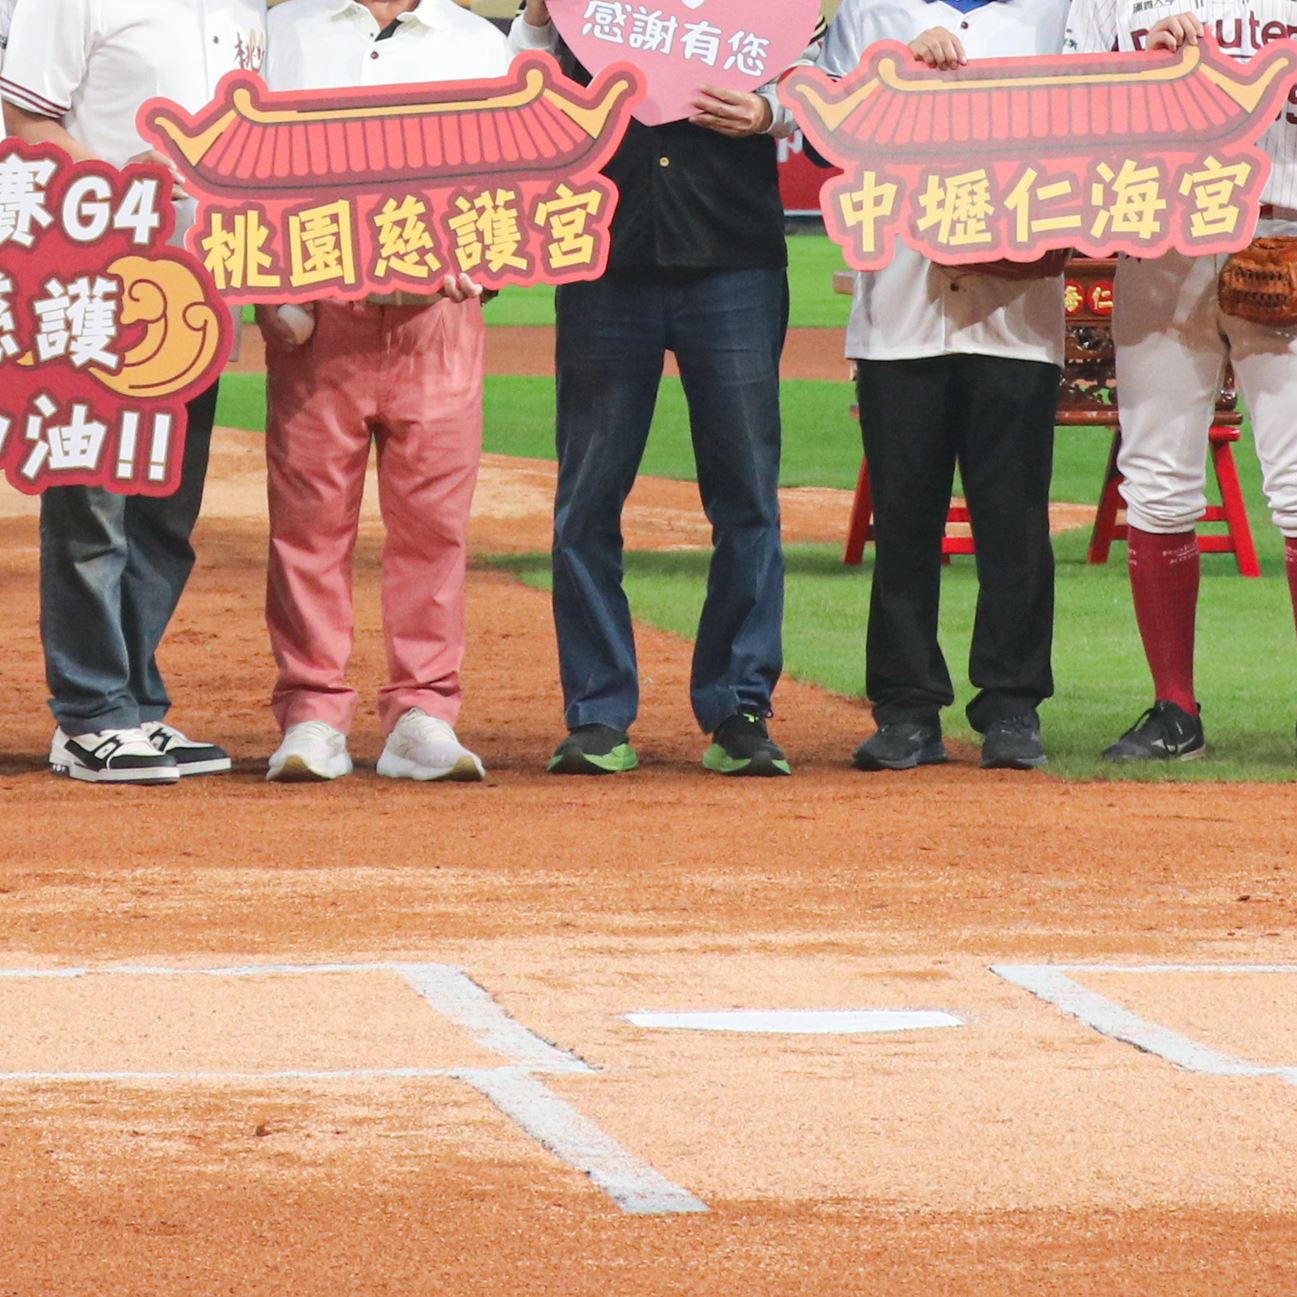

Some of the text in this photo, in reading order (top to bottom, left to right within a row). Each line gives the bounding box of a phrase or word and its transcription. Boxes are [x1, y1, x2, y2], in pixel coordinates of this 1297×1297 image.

[582, 0, 771, 78] 感謝有您
[202, 183, 604, 291] 桃園慈護宮
[839, 154, 1254, 254] 中壢仁海宮
